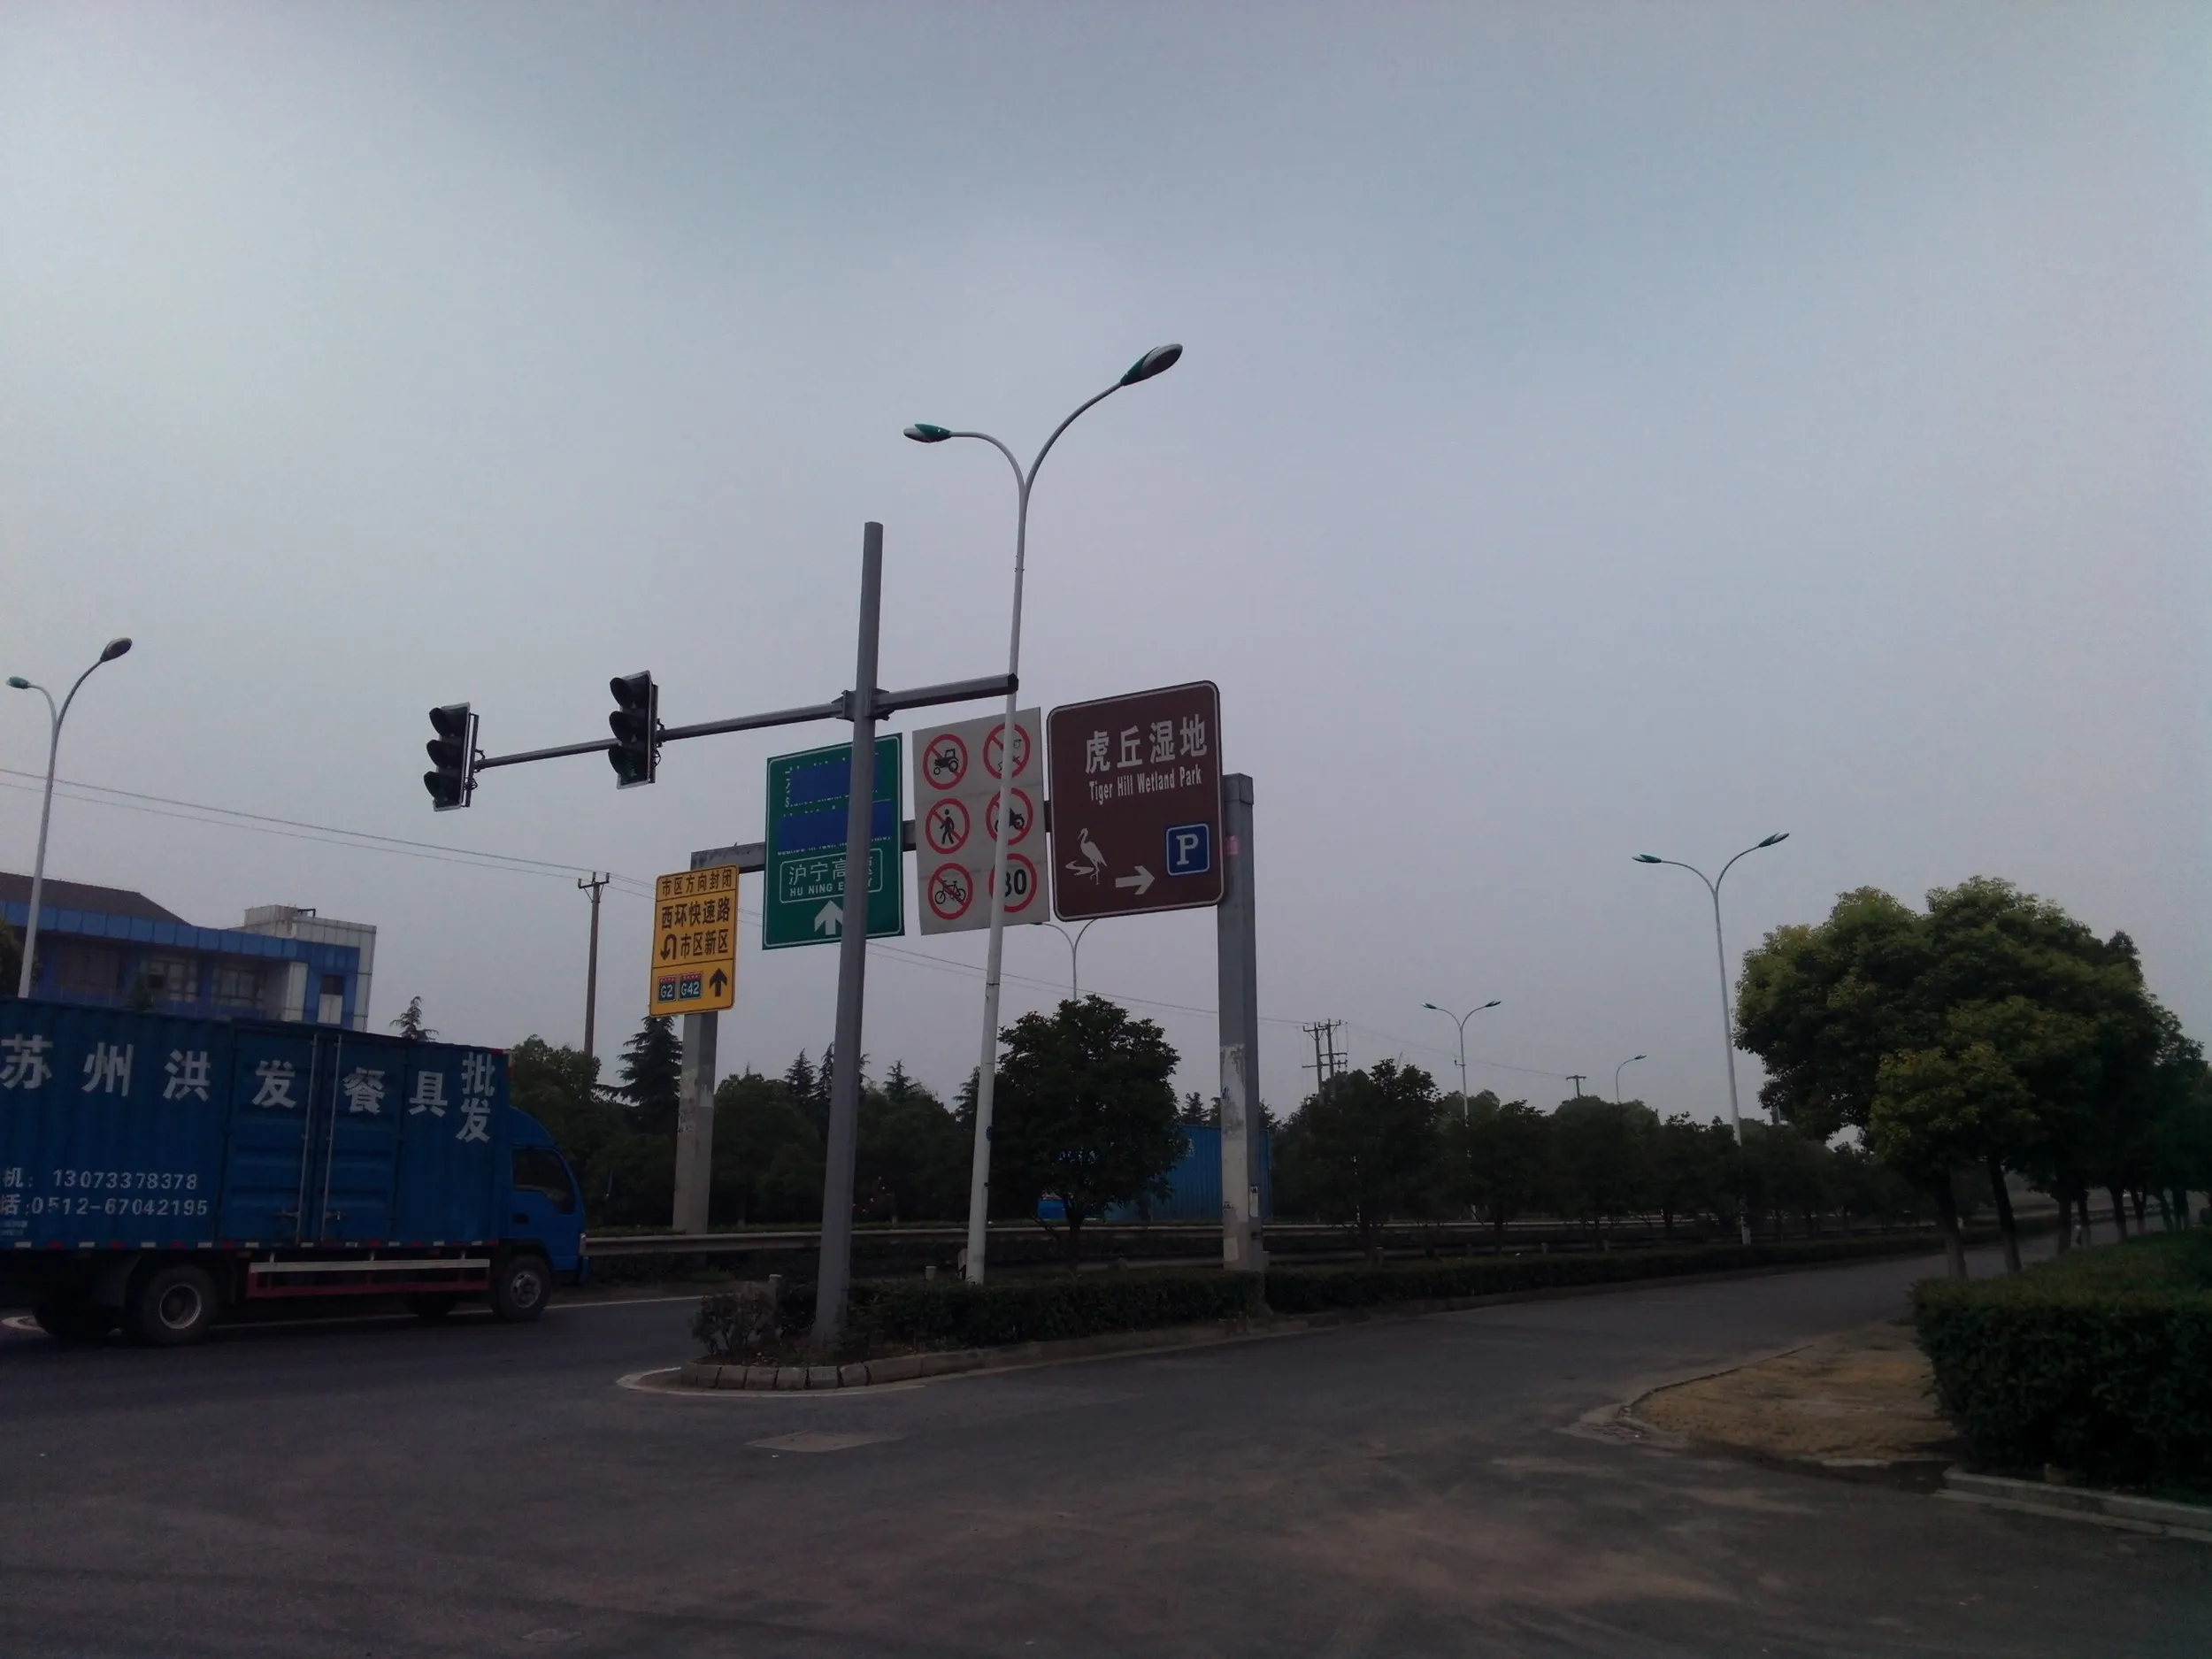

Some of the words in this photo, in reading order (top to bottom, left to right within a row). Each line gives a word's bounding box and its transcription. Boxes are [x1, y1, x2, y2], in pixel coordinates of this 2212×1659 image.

[1085, 713, 1208, 775] 虎丘湿地
[1088, 780, 1114, 806] Tiger
[1117, 775, 1133, 797] Hill
[1137, 768, 1175, 794] Wetland
[1179, 764, 1202, 787] Park
[1175, 833, 1199, 865] P
[662, 868, 733, 897] 市区方向封闭
[789, 887, 803, 897] HU
[808, 883, 833, 895] NING
[661, 897, 731, 931] 西环快速路
[680, 928, 729, 959] 市区新区
[660, 984, 673, 998] G2
[680, 980, 700, 996] G42
[52, 1169, 198, 1190] 13073378378
